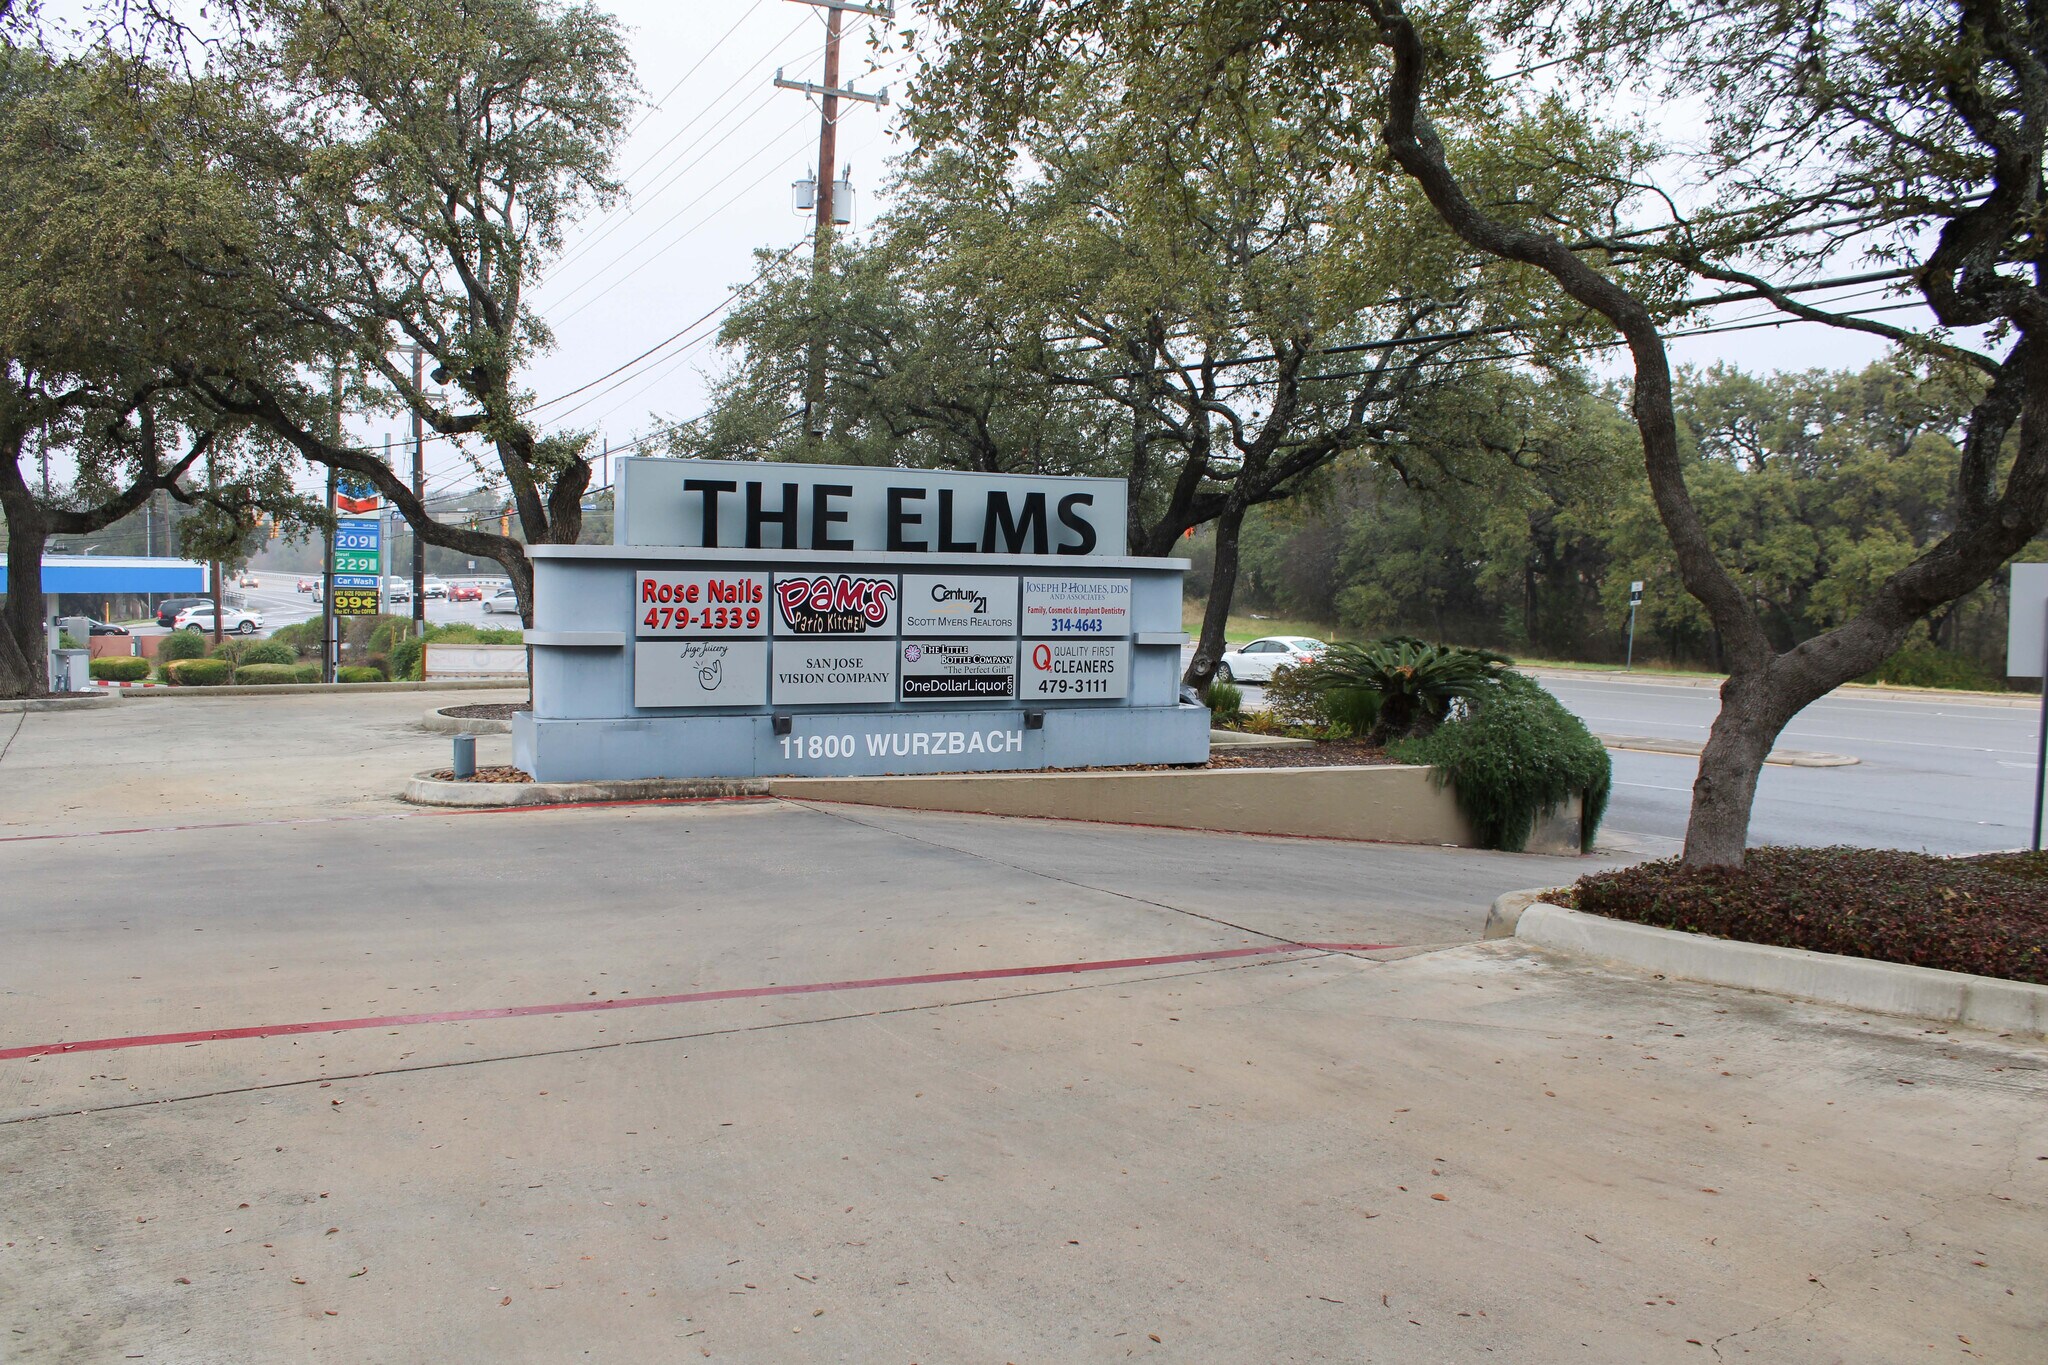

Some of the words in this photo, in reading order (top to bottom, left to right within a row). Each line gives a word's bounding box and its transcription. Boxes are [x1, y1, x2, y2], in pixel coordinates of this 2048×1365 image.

[683, 479, 854, 551] THE
[886, 486, 1098, 555] ELMS
[337, 535, 369, 547] 209
[336, 558, 368, 570] 229
[337, 577, 351, 585] Car
[353, 577, 374, 585] Wash
[642, 579, 700, 603] Rose
[707, 579, 763, 603] Nails
[931, 584, 979, 603] Century
[1026, 582, 1059, 593] JOSEPH
[1068, 583, 1109, 594] HOLMES,
[1110, 585, 1129, 594] DDS
[973, 597, 987, 614] 21
[1027, 606, 1048, 615] Family,
[1048, 606, 1073, 614] Cosmetic
[1078, 607, 1101, 616] Implant
[1101, 607, 1126, 616] Dentistry
[643, 607, 761, 629] 479-1339
[907, 616, 937, 627] SCOTT
[938, 617, 968, 627] MYERS
[970, 617, 1013, 627] REALTORS
[1051, 618, 1103, 632] 314-4643
[922, 644, 941, 654] THE
[941, 644, 968, 654] LITTLE
[1054, 646, 1089, 657] QUALITY
[1091, 646, 1115, 657] FIRST
[806, 658, 832, 669] SAN
[832, 658, 864, 670] JOSE
[941, 655, 972, 665] BOTTLE
[973, 655, 1014, 665] COMPANY
[1033, 644, 1052, 672] Q
[944, 665, 962, 674] "The
[964, 665, 990, 674] Perfect
[991, 665, 1011, 674] Gift"
[1054, 660, 1114, 674] CLEANERS
[779, 673, 824, 684] VISION
[827, 673, 890, 683] COMPANY
[904, 679, 1006, 694] OneDollarLiquor
[1038, 679, 1107, 693] 479-3111
[779, 734, 856, 760] 11800
[865, 729, 1023, 757] WURZBACH
